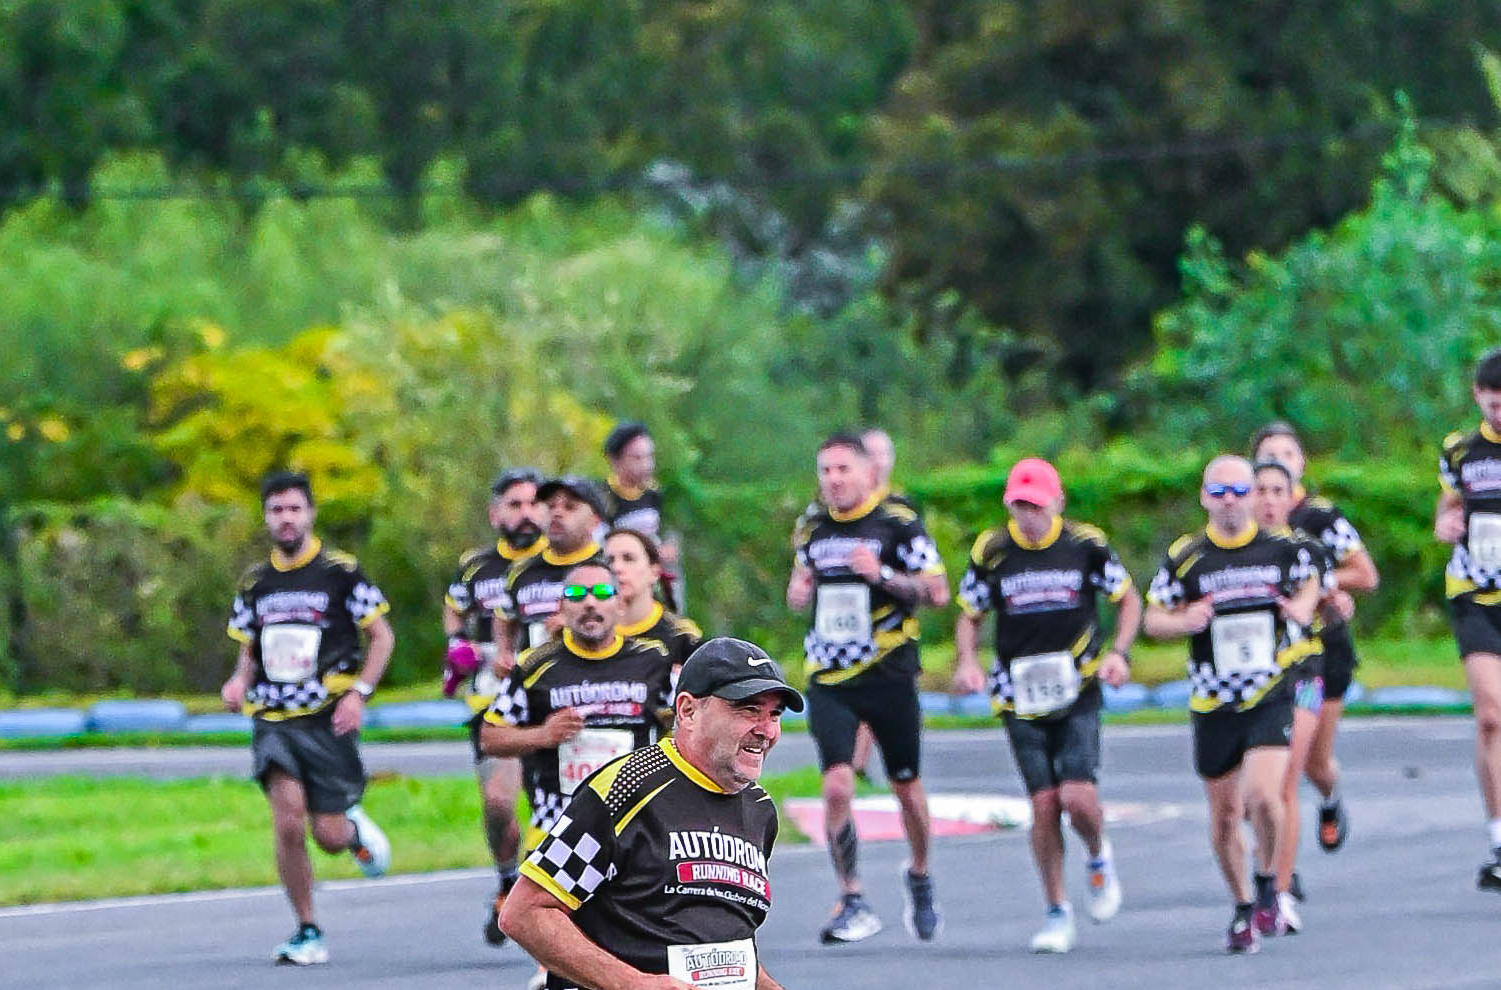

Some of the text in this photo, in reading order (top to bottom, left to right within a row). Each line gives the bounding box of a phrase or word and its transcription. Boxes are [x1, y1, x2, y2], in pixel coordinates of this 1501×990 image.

[563, 761, 603, 781] 40
[668, 826, 769, 881] AUTÓDROM
[664, 885, 675, 894] La
[691, 864, 766, 895] RUNNING RACE
